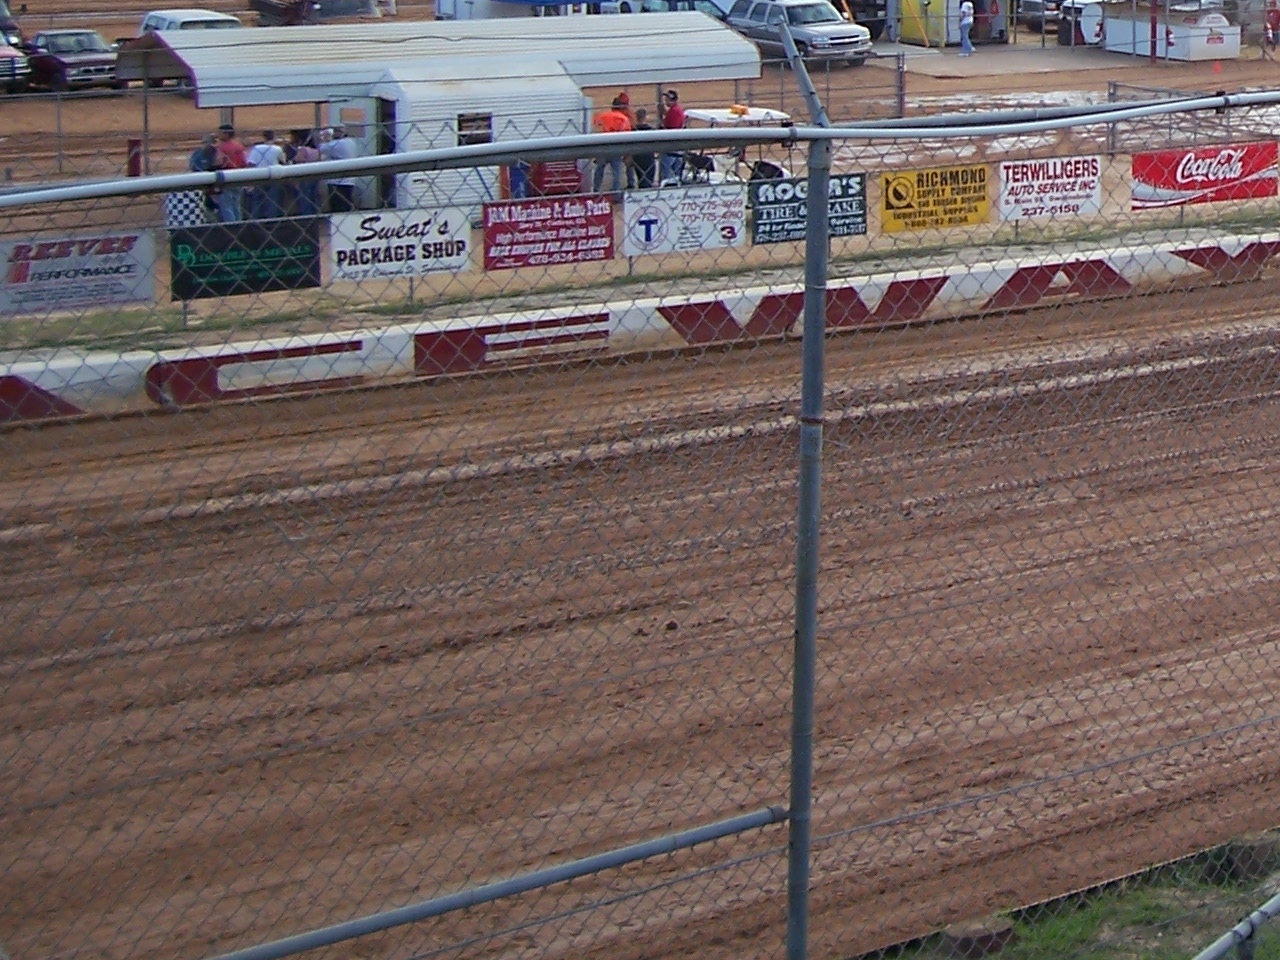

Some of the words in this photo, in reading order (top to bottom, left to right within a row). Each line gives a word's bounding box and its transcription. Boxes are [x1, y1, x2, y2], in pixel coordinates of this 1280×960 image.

[916, 167, 986, 188] RICHMOND
[1003, 158, 1099, 184] TERWILLIGERS
[758, 176, 862, 202] ROGR'S
[1008, 185, 1034, 197] AUTO
[1036, 181, 1077, 194] SERVICE
[1078, 180, 1097, 191] INC
[586, 199, 611, 216] Parts
[761, 206, 795, 220] TIRE
[355, 211, 450, 242] Sweat's
[638, 218, 659, 242] T
[720, 225, 737, 240] 3
[336, 243, 417, 268] PACKAGE
[421, 239, 467, 260] SHOP
[30, 263, 138, 282] PERFORMANCE
